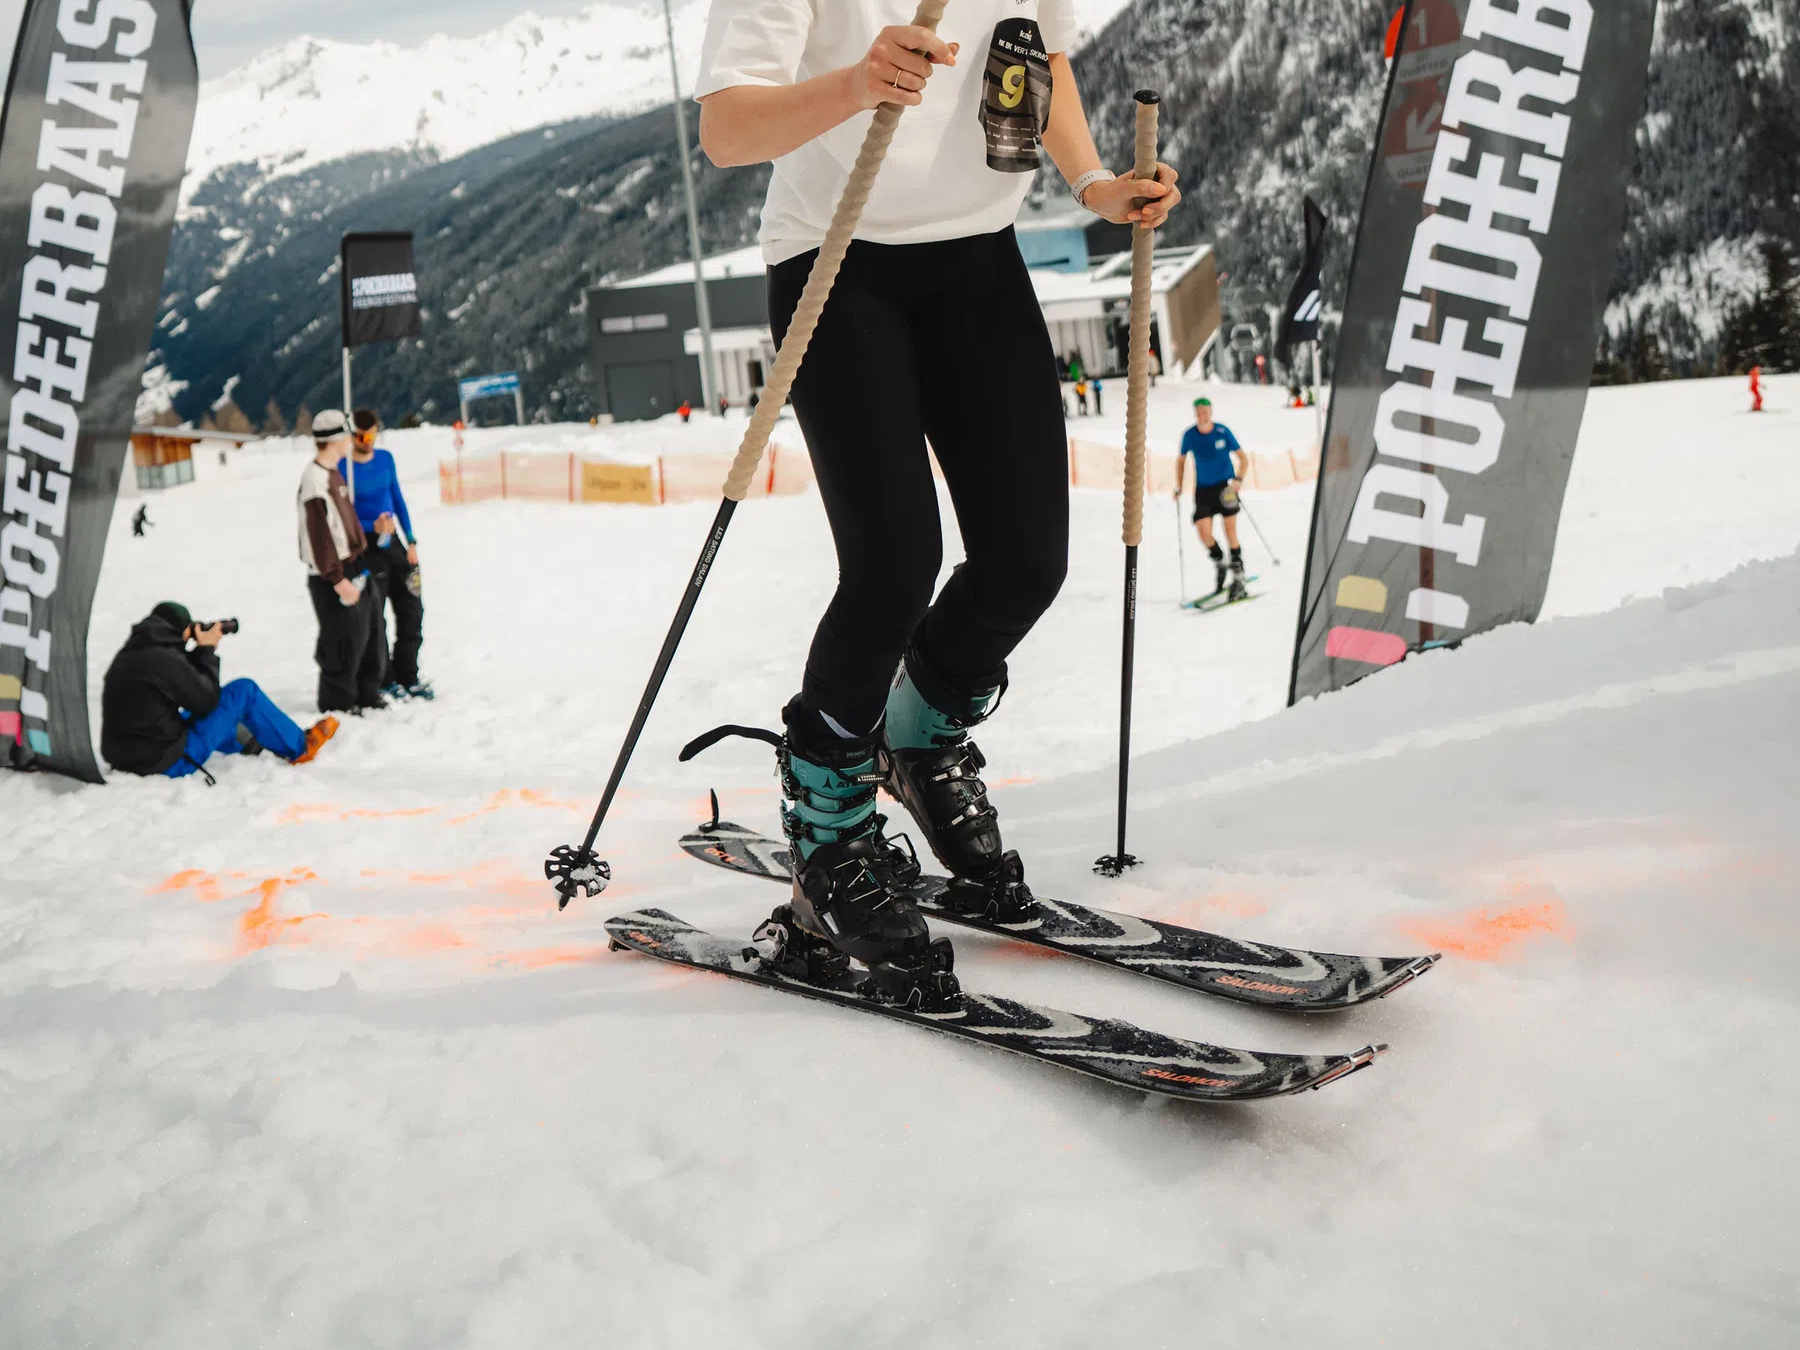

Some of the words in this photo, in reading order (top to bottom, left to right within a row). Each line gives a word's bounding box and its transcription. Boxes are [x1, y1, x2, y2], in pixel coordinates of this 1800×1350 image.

[1029, 49, 1048, 62] SKIMO
[715, 527, 724, 539] LES
[1215, 975, 1301, 995] SALOMON
[1141, 1068, 1231, 1087] SALOMON
